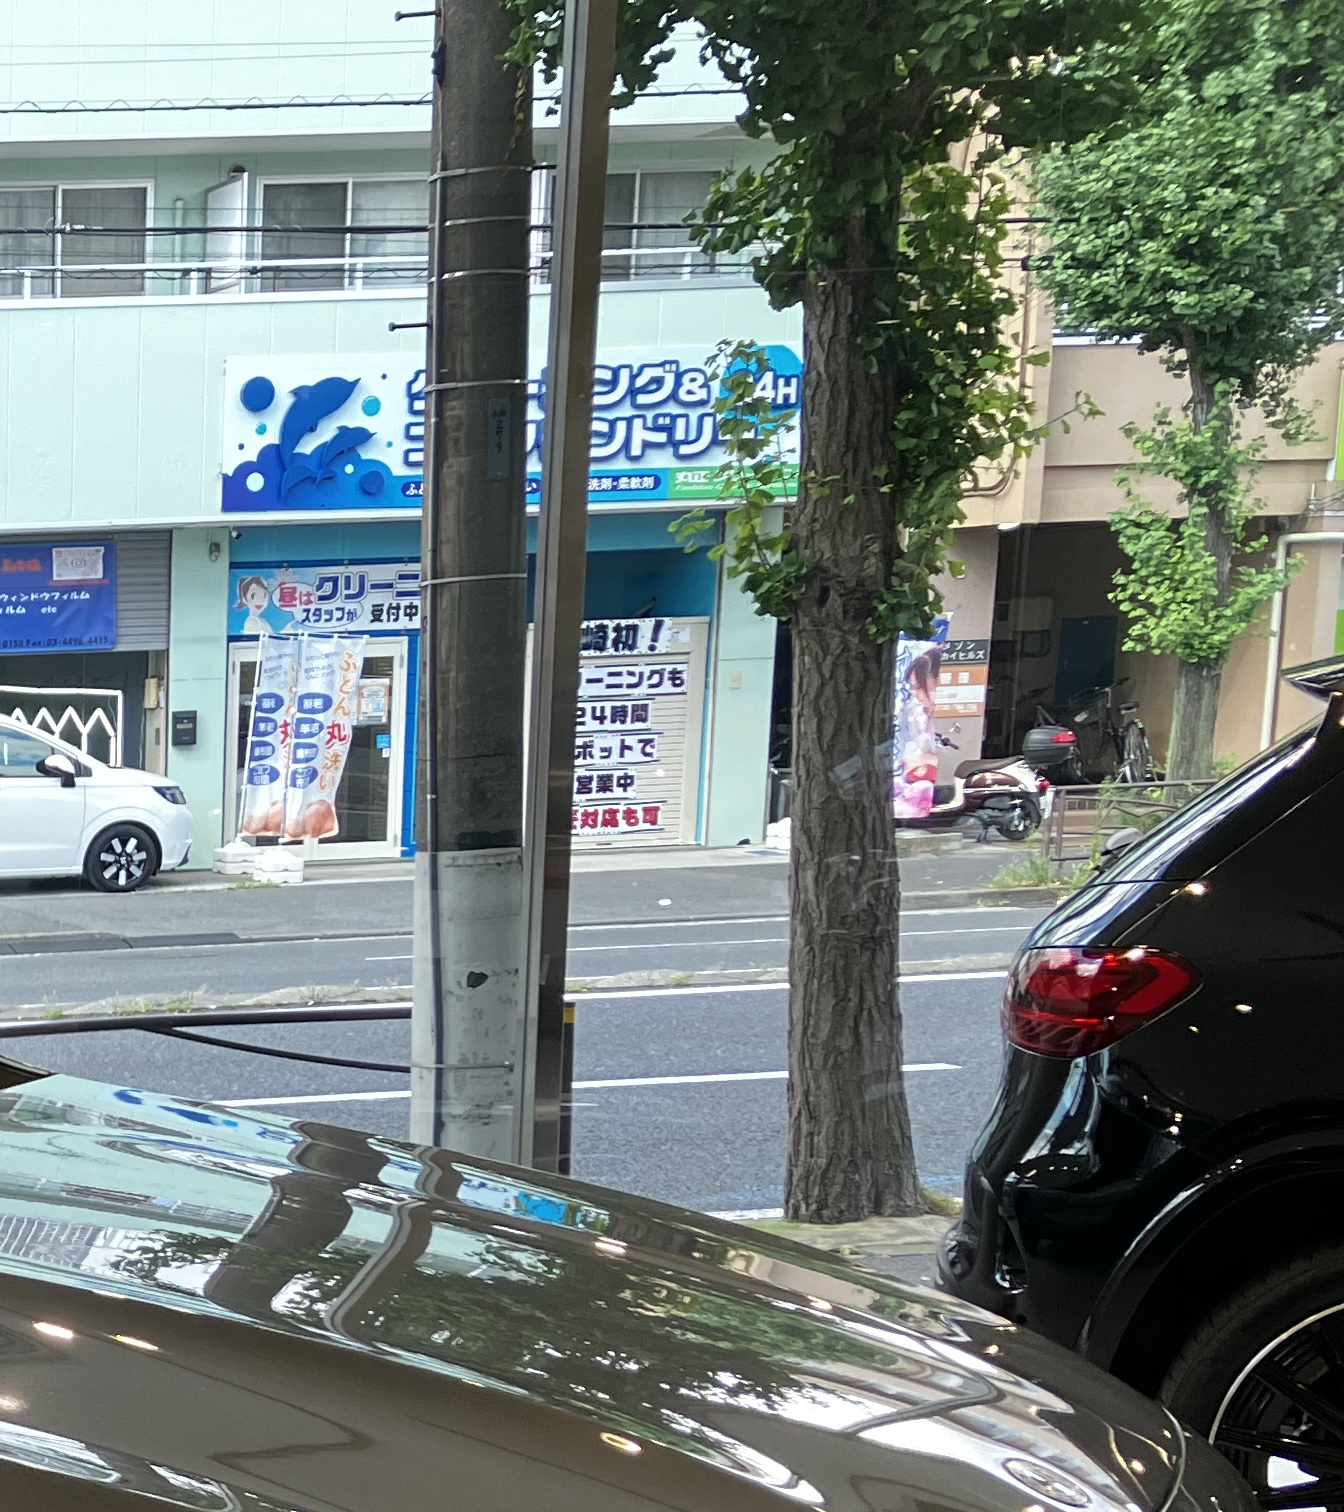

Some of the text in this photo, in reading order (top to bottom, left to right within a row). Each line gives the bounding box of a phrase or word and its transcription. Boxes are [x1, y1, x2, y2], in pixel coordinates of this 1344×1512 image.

[301, 602, 419, 623] スタッフが 受付中
[579, 667, 686, 690] ーニングも
[575, 772, 635, 795] 営業中
